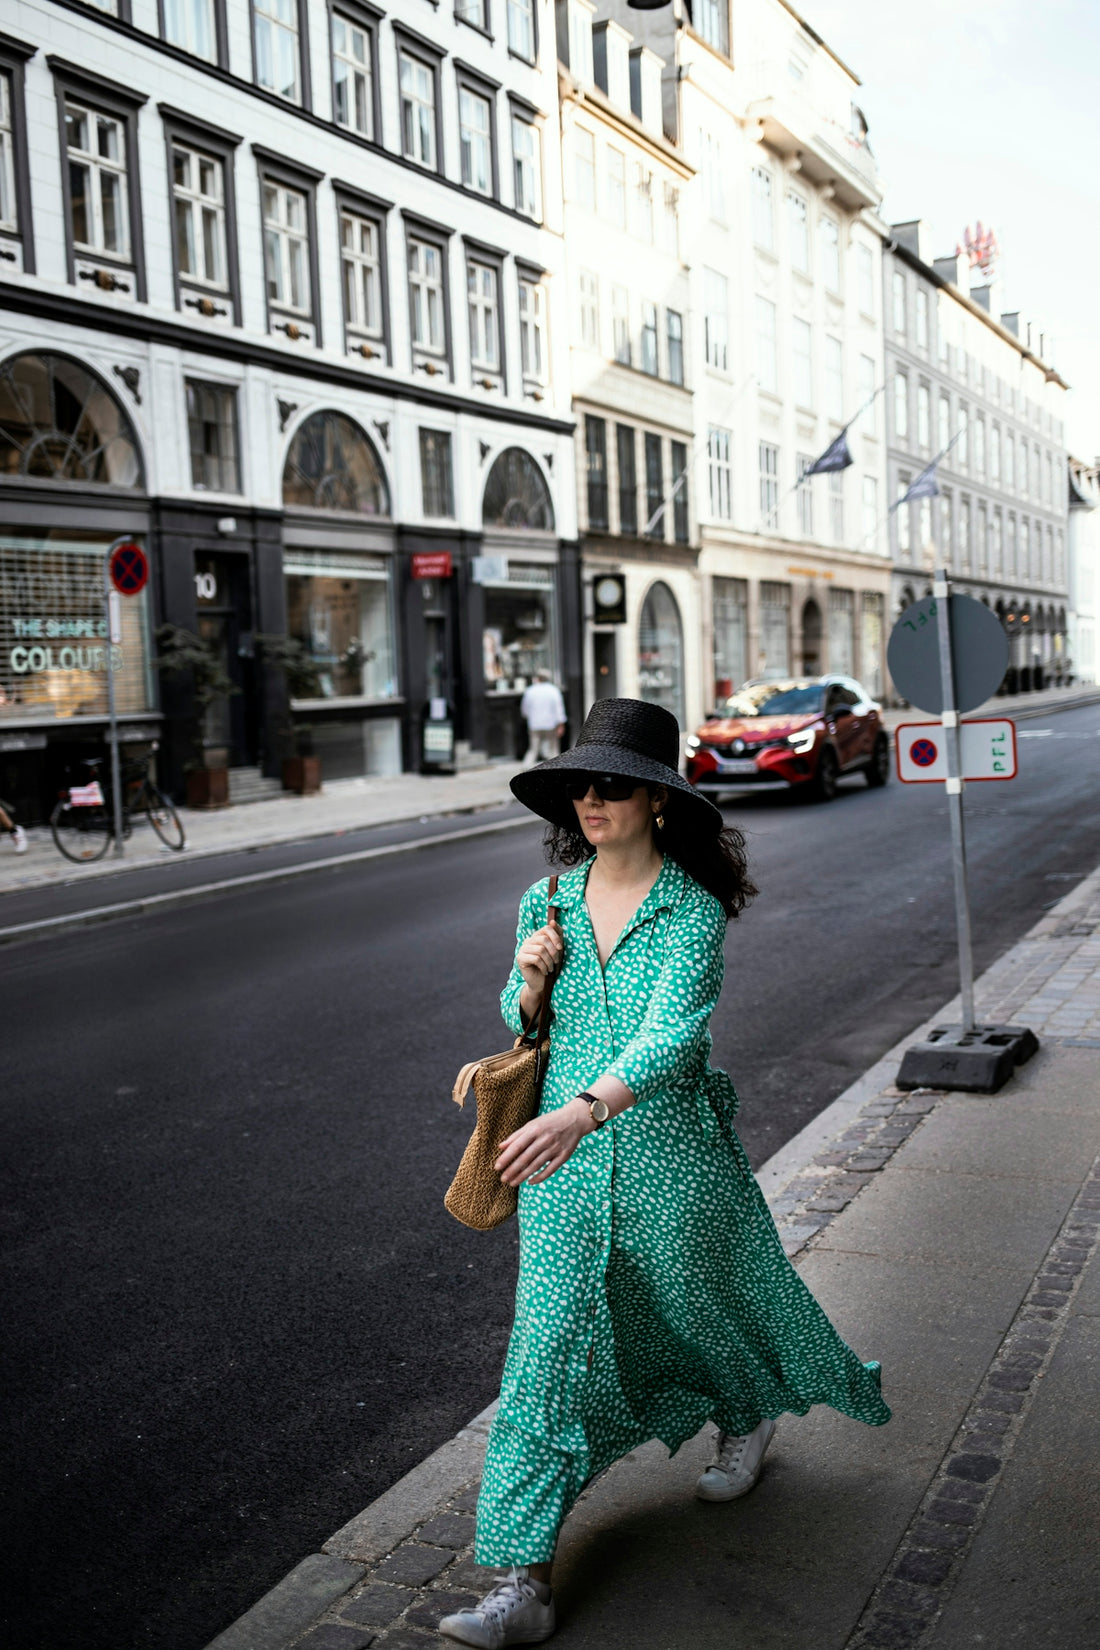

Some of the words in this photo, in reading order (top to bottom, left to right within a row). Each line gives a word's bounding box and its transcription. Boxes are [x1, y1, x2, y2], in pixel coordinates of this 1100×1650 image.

[193, 573, 217, 599] 10
[12, 619, 42, 638] THE
[45, 619, 95, 638] SHAPE
[10, 646, 122, 673] COLOURS
[992, 731, 1006, 772] PFL
